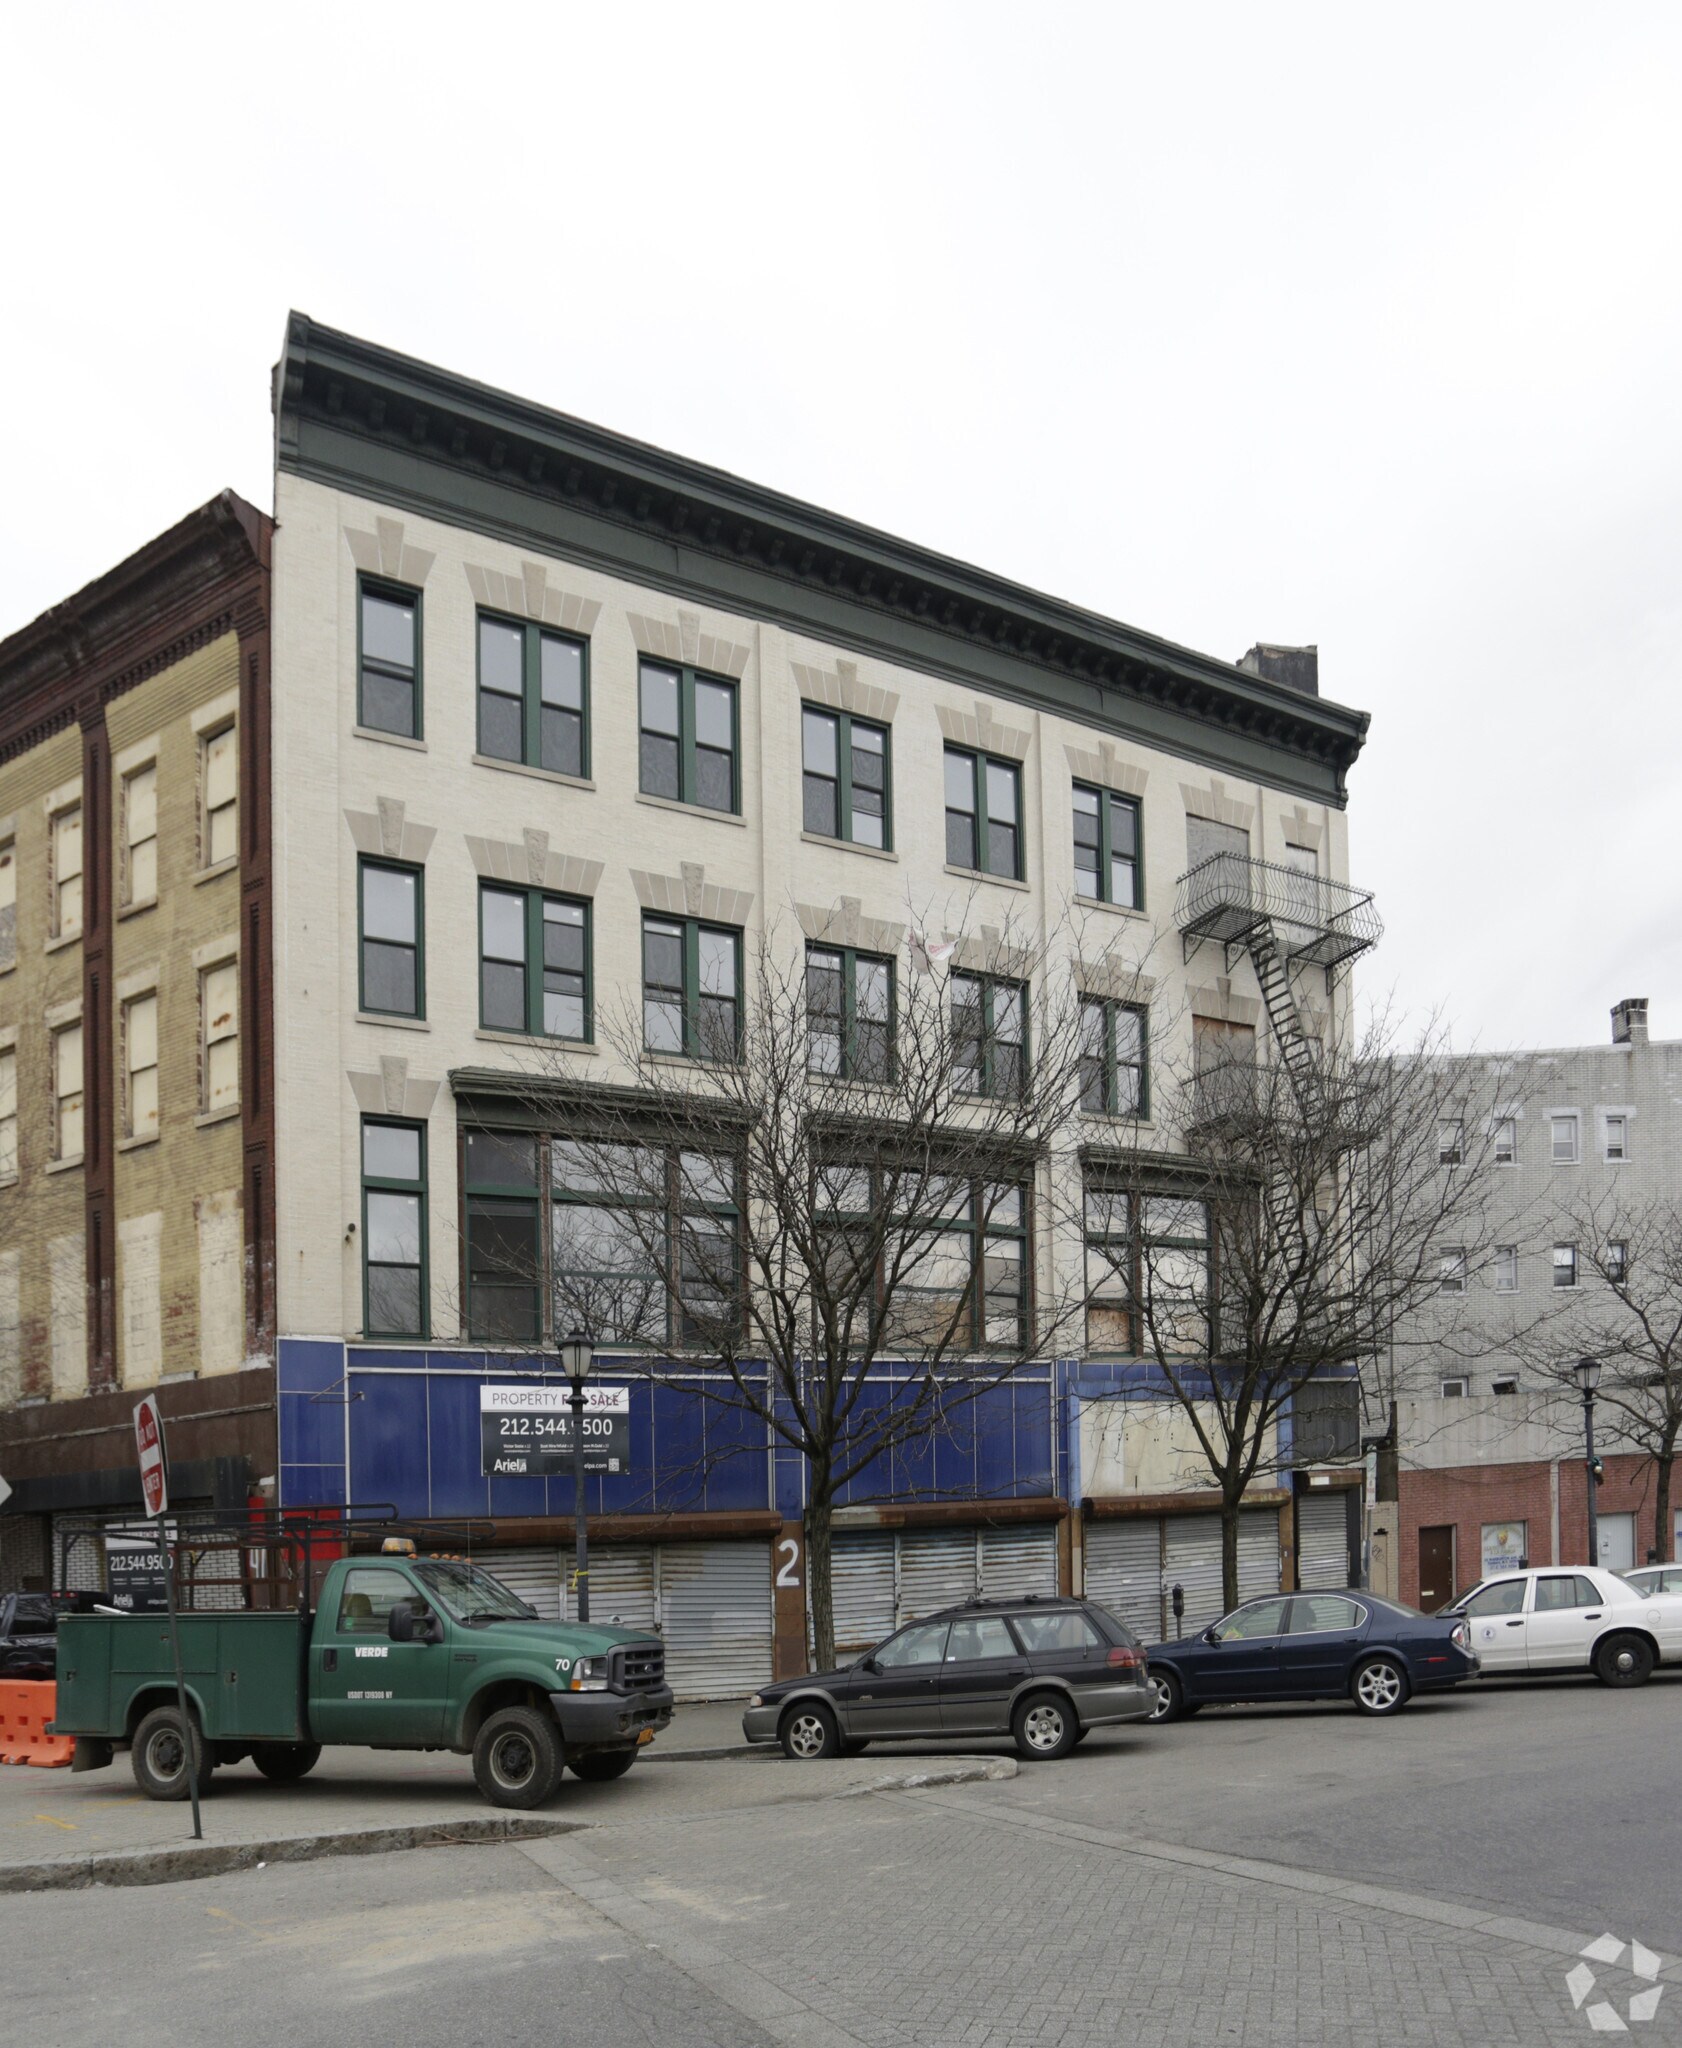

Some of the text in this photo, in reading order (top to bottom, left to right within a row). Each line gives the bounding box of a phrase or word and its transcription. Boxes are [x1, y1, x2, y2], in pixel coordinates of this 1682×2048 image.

[492, 1392, 557, 1406] PROPERTY
[590, 1394, 619, 1406] SALE
[500, 1418, 613, 1435] 212.544.500
[776, 1539, 799, 1586] 2
[355, 1647, 388, 1657] VERDE
[555, 1658, 570, 1671] 70
